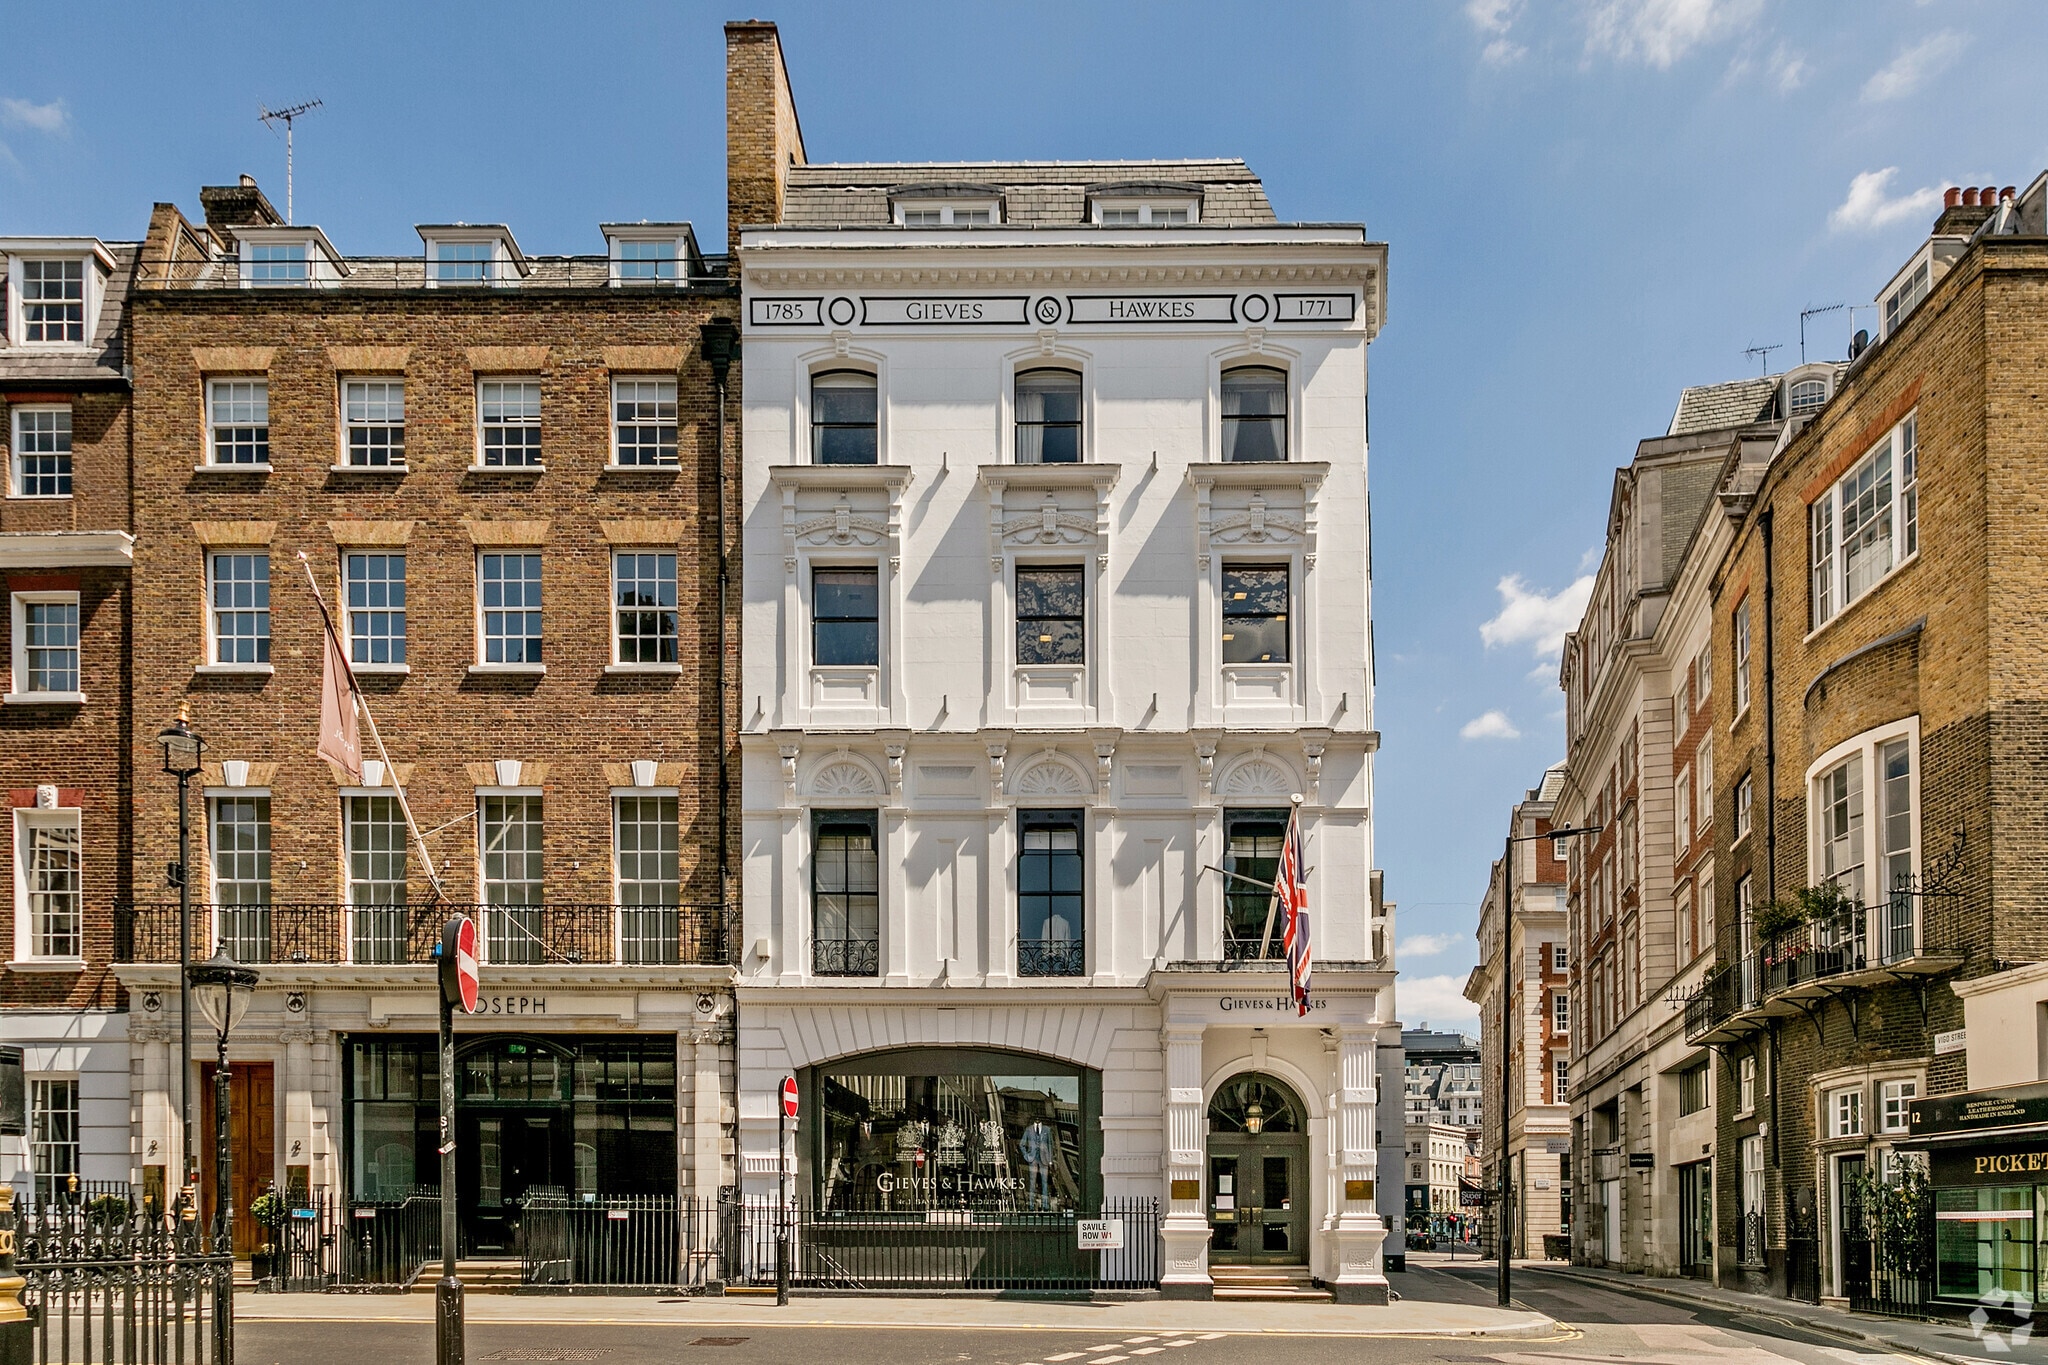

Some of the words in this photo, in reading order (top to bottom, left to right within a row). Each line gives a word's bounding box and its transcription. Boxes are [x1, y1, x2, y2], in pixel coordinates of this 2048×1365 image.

[766, 303, 804, 320] 1785
[906, 302, 983, 320] GIEVES
[1041, 302, 1055, 318] &
[1109, 301, 1195, 318] HAWKES
[1299, 300, 1332, 316] 1771
[459, 998, 546, 1014] OSEPH
[1220, 996, 1264, 1011] GIEVES
[1265, 1000, 1273, 1009] &
[1276, 997, 1327, 1011] HAKES
[1938, 1035, 1950, 1044] VIGO
[1966, 1100, 1993, 1108] BESPOKE
[1968, 1104, 2015, 1114] LEATHERGOODS
[1912, 1112, 1921, 1123] 12
[1959, 1112, 1990, 1121] HANDMADE
[1997, 1108, 2026, 1117] ENGLAND
[877, 1172, 937, 1192] GIEVES
[941, 1178, 953, 1190] &
[956, 1173, 1026, 1192] HAWKES
[1082, 1222, 1107, 1231] SAVILE
[1082, 1231, 1099, 1240] ROW
[1100, 1231, 1112, 1239] W1
